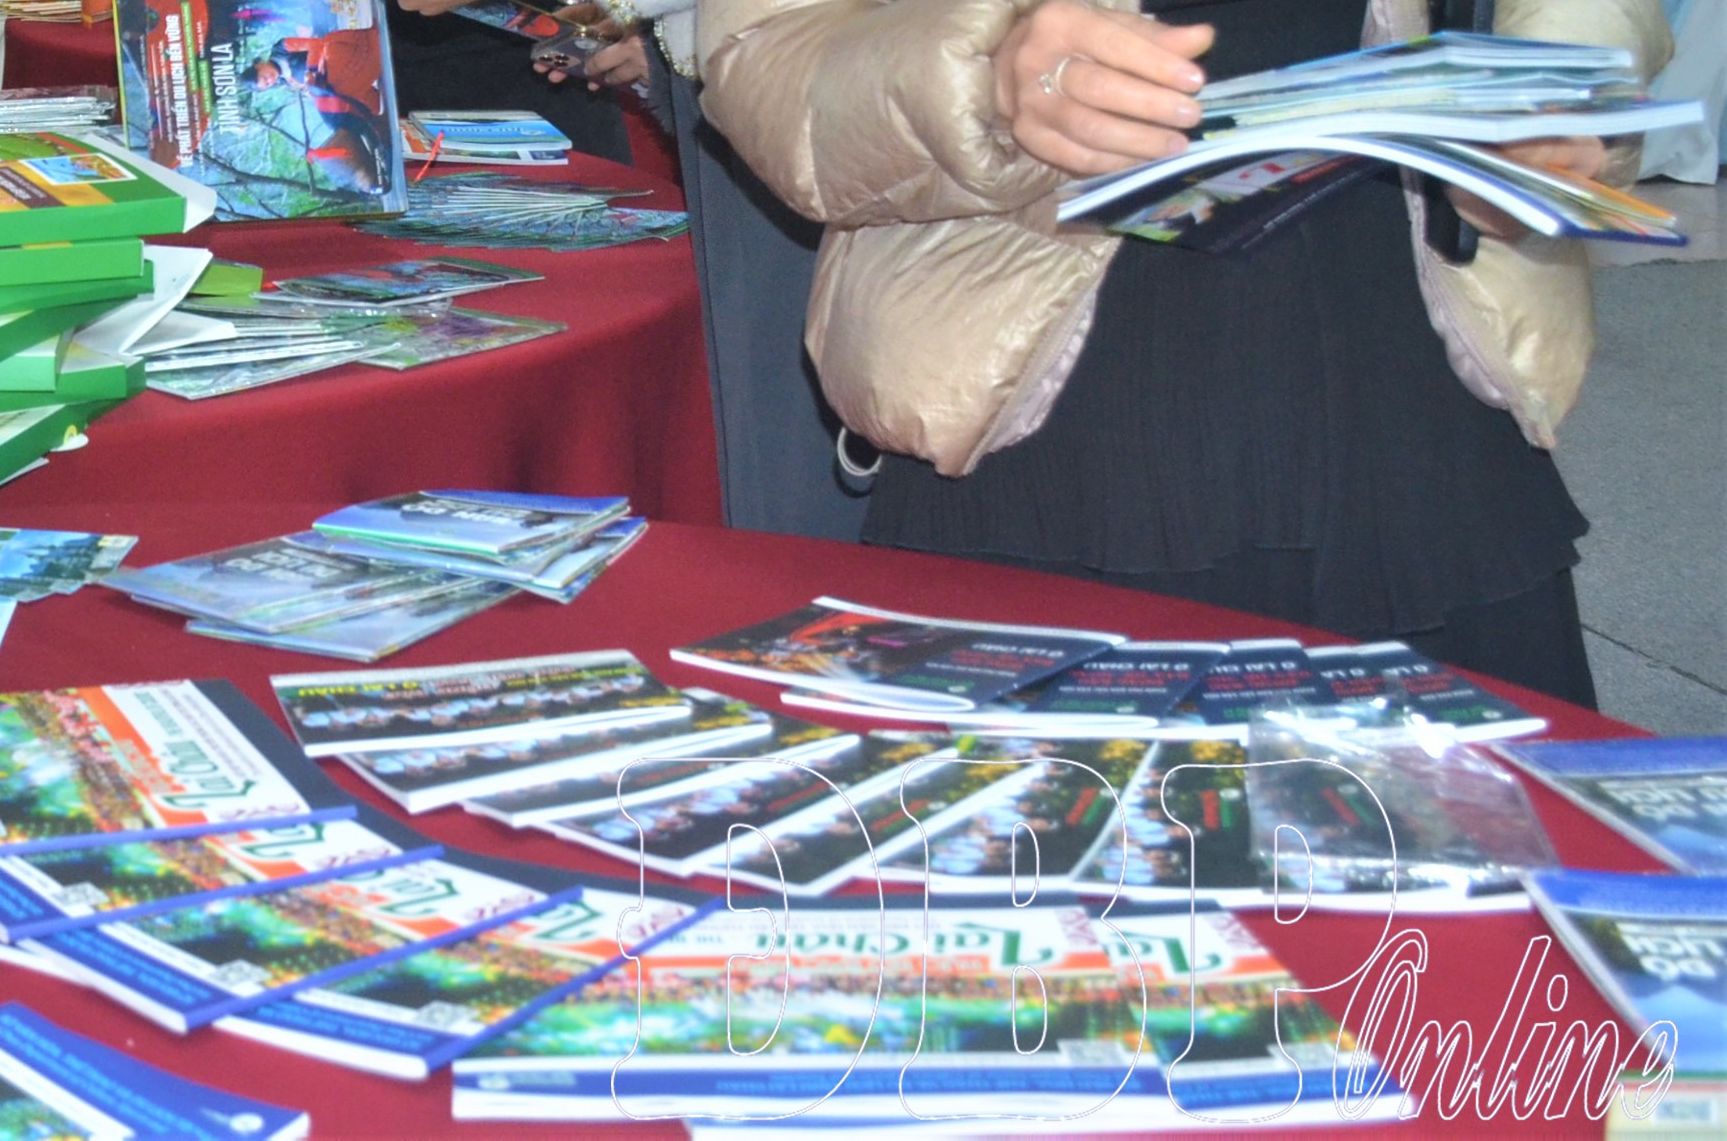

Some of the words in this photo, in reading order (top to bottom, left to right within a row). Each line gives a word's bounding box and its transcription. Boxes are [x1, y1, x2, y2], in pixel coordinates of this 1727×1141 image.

[211, 42, 234, 61] LA
[171, 62, 186, 84] LỊCH
[212, 61, 237, 95] SƠN
[174, 84, 188, 100] DU
[171, 100, 189, 129] TRIỂN
[217, 97, 241, 134] TỈNH
[176, 128, 192, 155] PHÁT
[754, 930, 910, 956] Châu
[933, 920, 1054, 968] Lai
[1104, 930, 1223, 975] La
